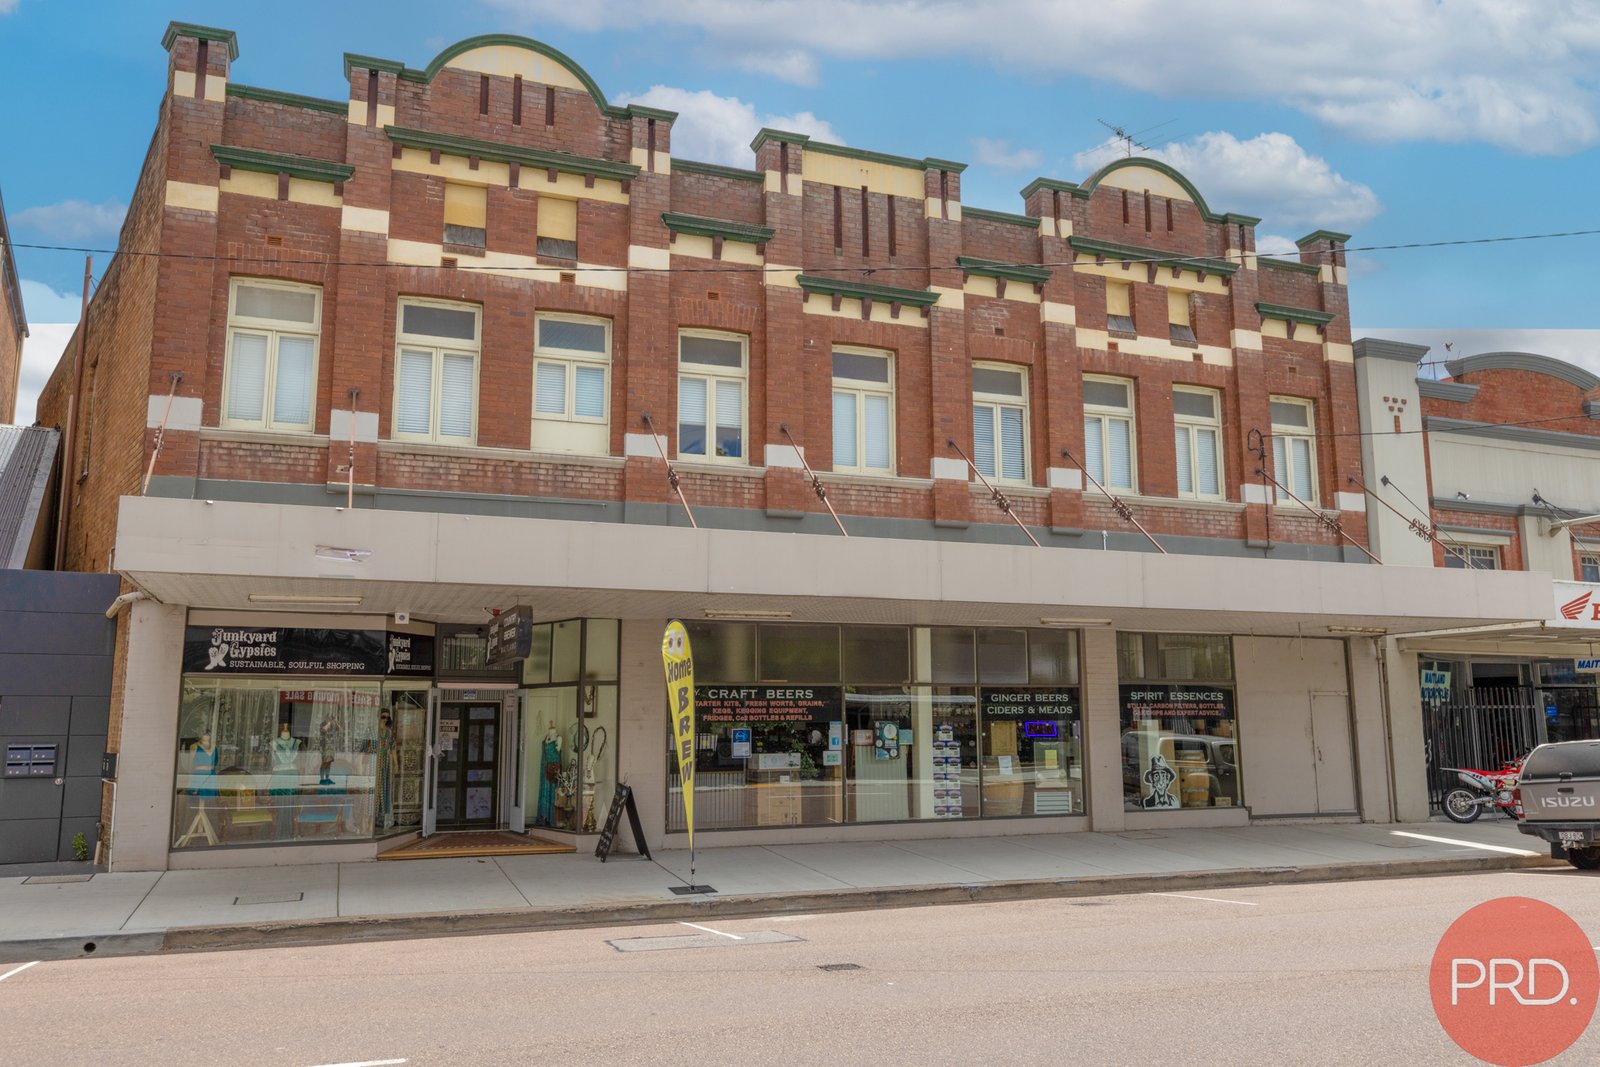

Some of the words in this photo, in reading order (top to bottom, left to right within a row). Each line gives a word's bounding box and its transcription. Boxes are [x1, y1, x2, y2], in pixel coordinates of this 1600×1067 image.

[211, 628, 277, 646] Junkyard
[230, 642, 277, 658] Gypsies
[229, 660, 286, 670] SUSTAINABLE,
[288, 661, 324, 669] SOULFUL
[326, 662, 365, 671] SHOPPING
[1577, 659, 1600, 669] MAIT
[667, 657, 692, 684] Home
[708, 689, 758, 699] CRAFT
[766, 689, 814, 699] BEERS
[991, 693, 1031, 702] GINGER
[1035, 693, 1069, 702] BEERS
[1130, 691, 1164, 700] SPIRIT
[1169, 692, 1224, 701] ESSENCES
[987, 706, 1024, 715] CIDERS
[1027, 706, 1035, 715] &
[1038, 706, 1073, 715] MEADS
[1541, 796, 1595, 808] ISUZU
